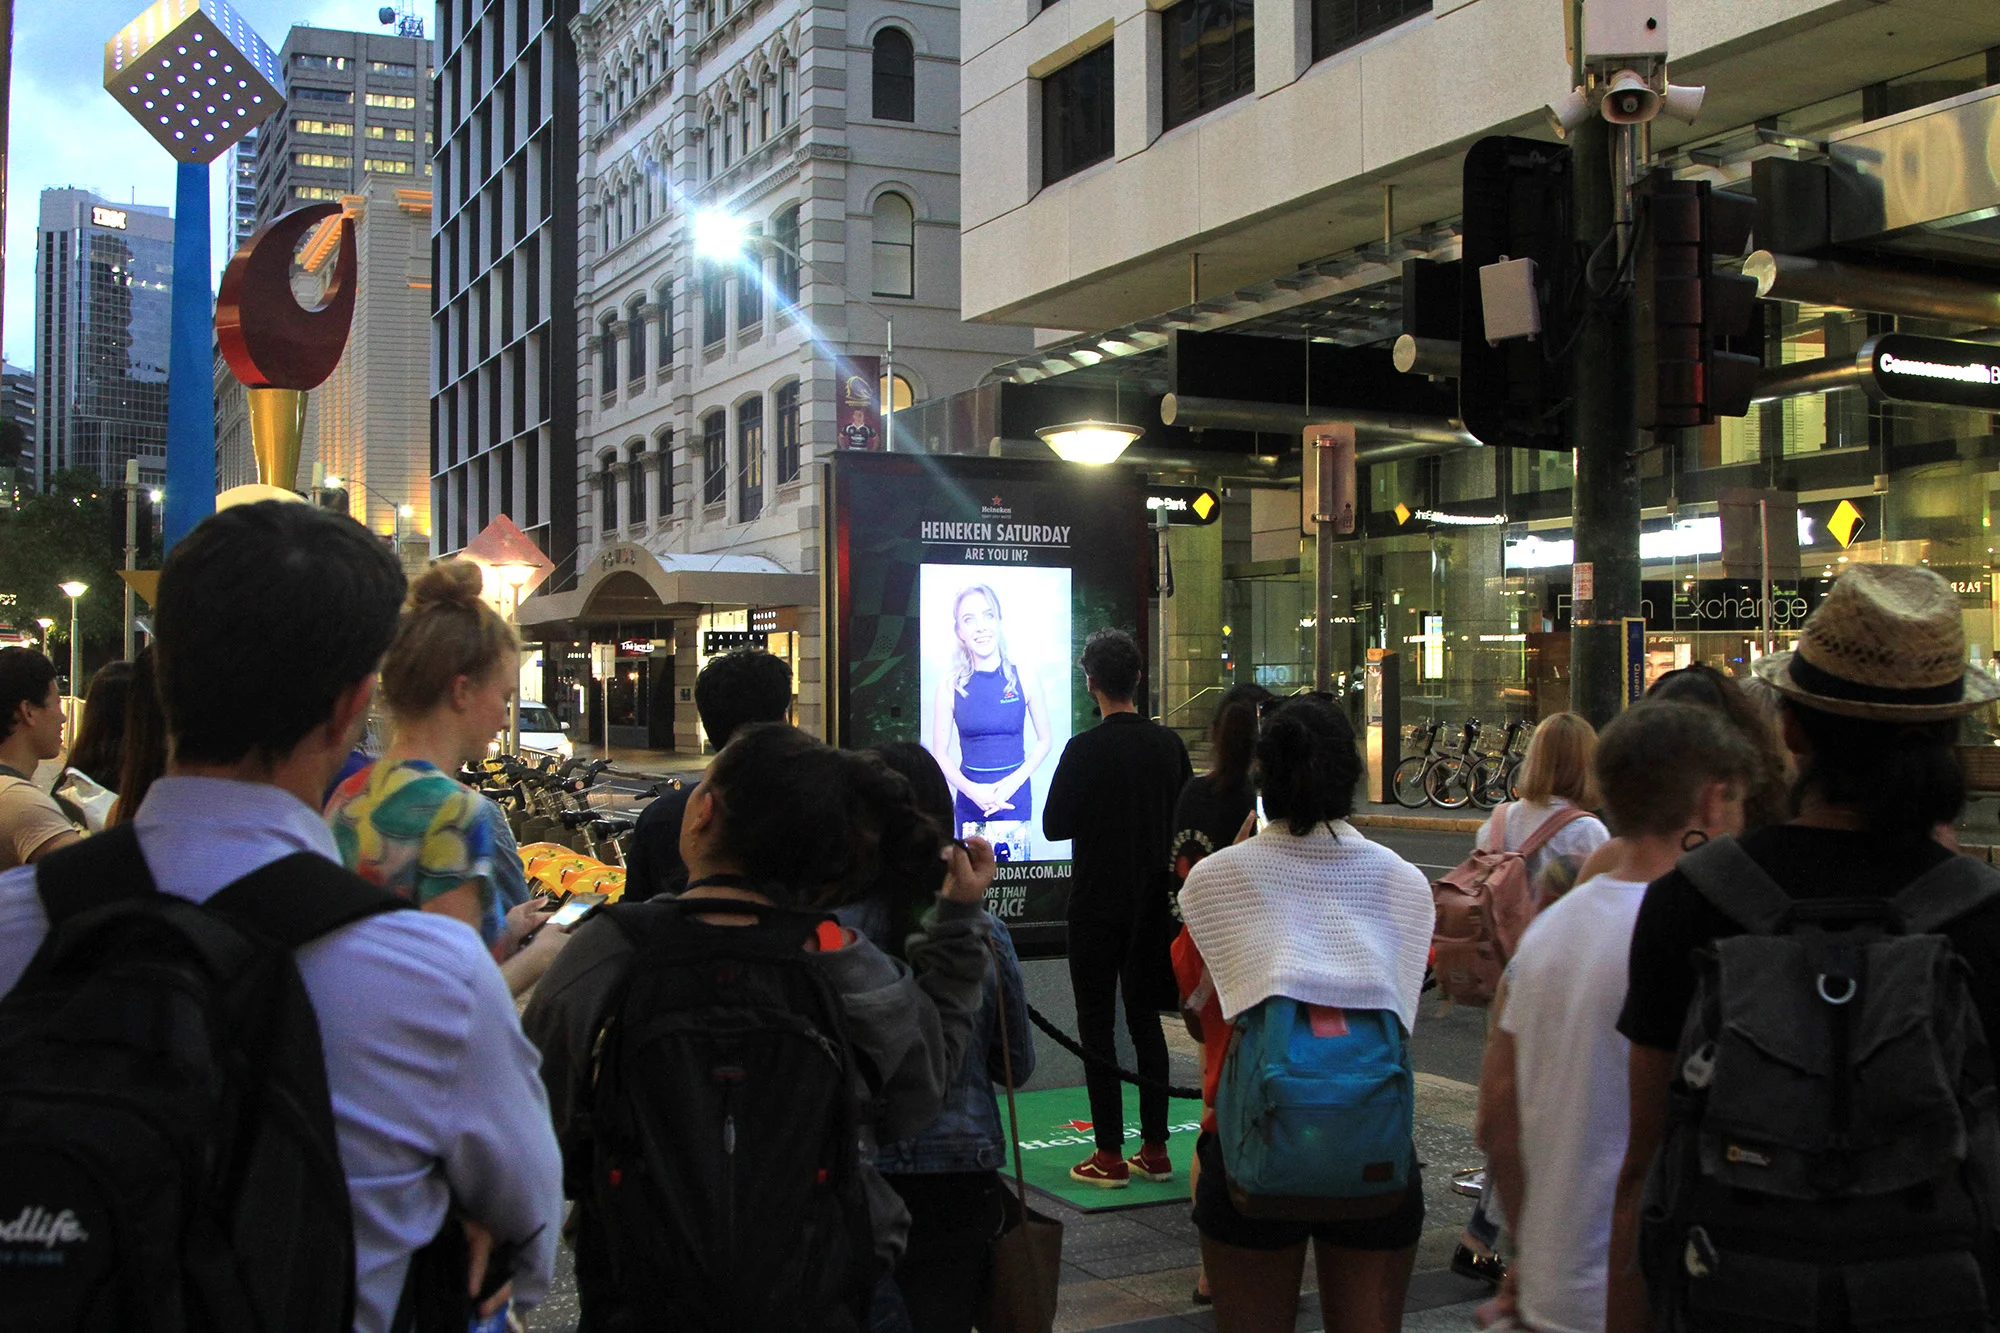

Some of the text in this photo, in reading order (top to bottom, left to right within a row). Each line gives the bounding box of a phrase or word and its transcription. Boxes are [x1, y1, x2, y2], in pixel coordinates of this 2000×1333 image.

[921, 521, 1071, 543] HEINEKEN SATURDAY
[964, 548, 1029, 561] ARE YOU IN?
[1672, 593, 1808, 625] Exchange
[1633, 664, 1641, 697] Queen
[993, 865, 1073, 881] URDAY.COM.AU
[983, 886, 1027, 899] ORE THAN
[988, 899, 1026, 918] RACE
